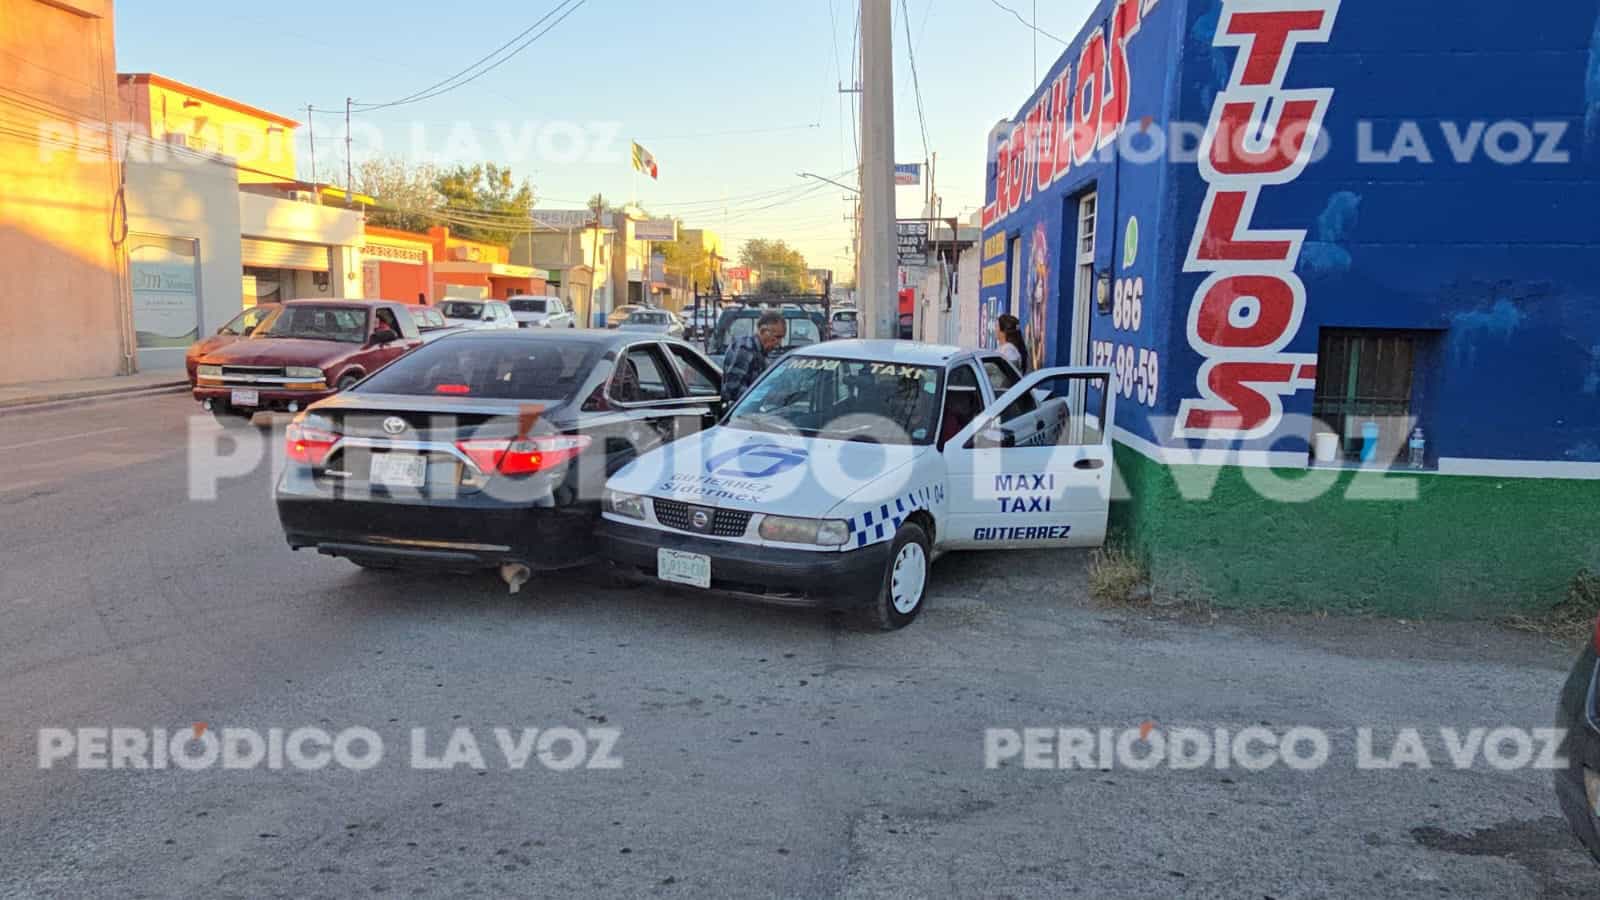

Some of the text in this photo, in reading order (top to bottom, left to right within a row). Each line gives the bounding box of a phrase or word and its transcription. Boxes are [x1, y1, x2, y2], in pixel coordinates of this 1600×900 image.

[1112, 276, 1143, 332] 866
[788, 359, 924, 379] MAXI TAXI
[670, 472, 774, 495] GUTIERREZ
[994, 473, 1055, 491] MAXI
[660, 481, 761, 504] Sidermex
[997, 496, 1052, 512] TAXI
[973, 525, 1072, 540] GUTIERREZ
